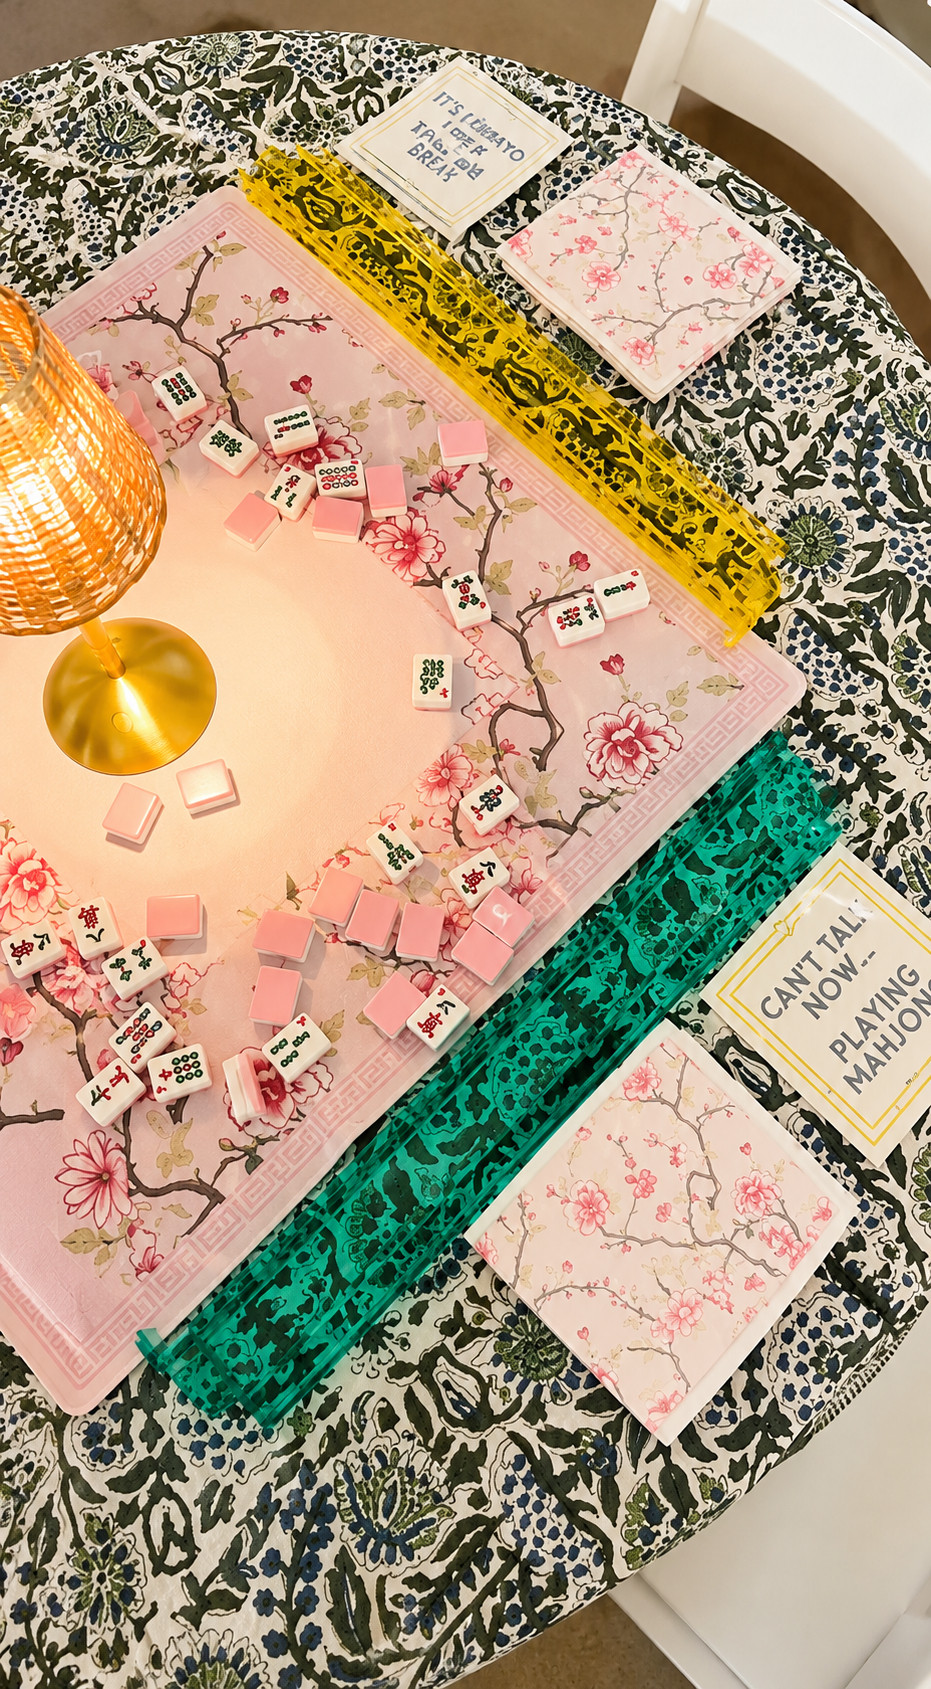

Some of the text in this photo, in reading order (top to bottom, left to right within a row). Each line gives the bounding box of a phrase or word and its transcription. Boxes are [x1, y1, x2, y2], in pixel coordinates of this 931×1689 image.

[432, 91, 464, 116] IT'S
[760, 899, 873, 1019] CAN'T TAL
[828, 964, 920, 1064] PLAYING
[842, 979, 931, 1095] MAHJON
